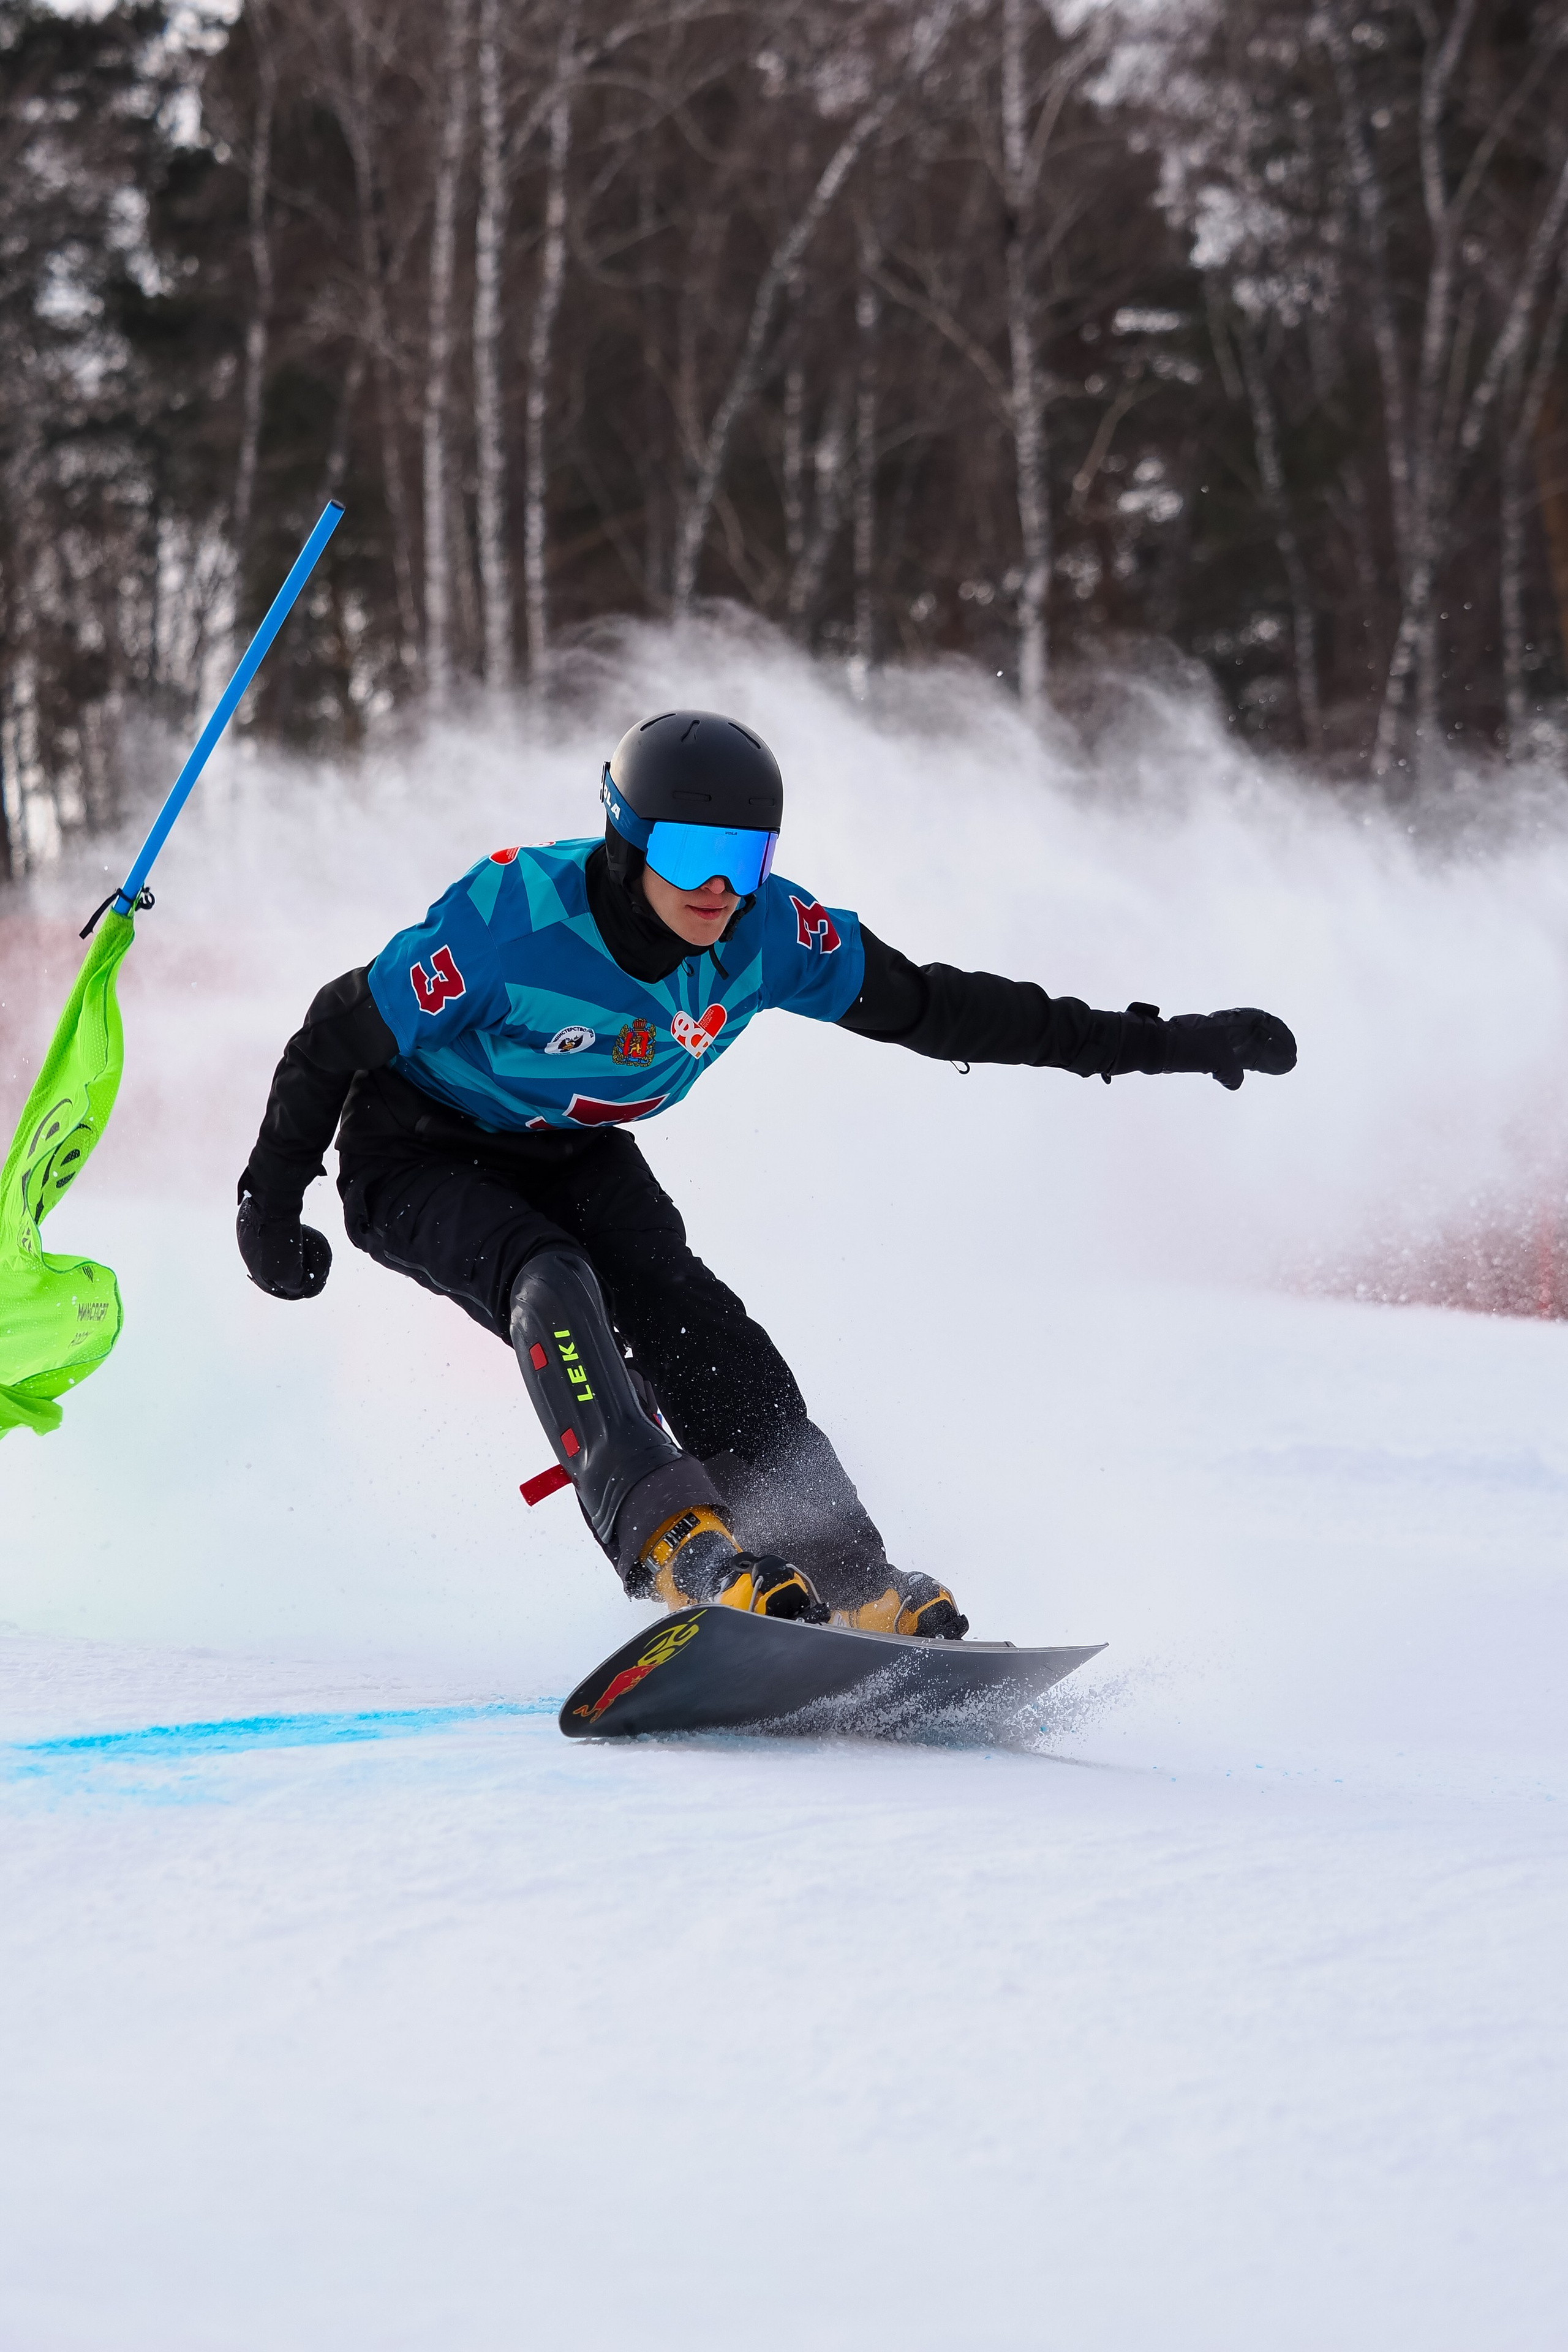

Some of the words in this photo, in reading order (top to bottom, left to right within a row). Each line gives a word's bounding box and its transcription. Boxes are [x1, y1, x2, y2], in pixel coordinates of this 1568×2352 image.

[604, 784, 620, 821] OLA
[789, 895, 842, 954] 3
[410, 944, 467, 1016] 3
[554, 1330, 594, 1401] LEKI
